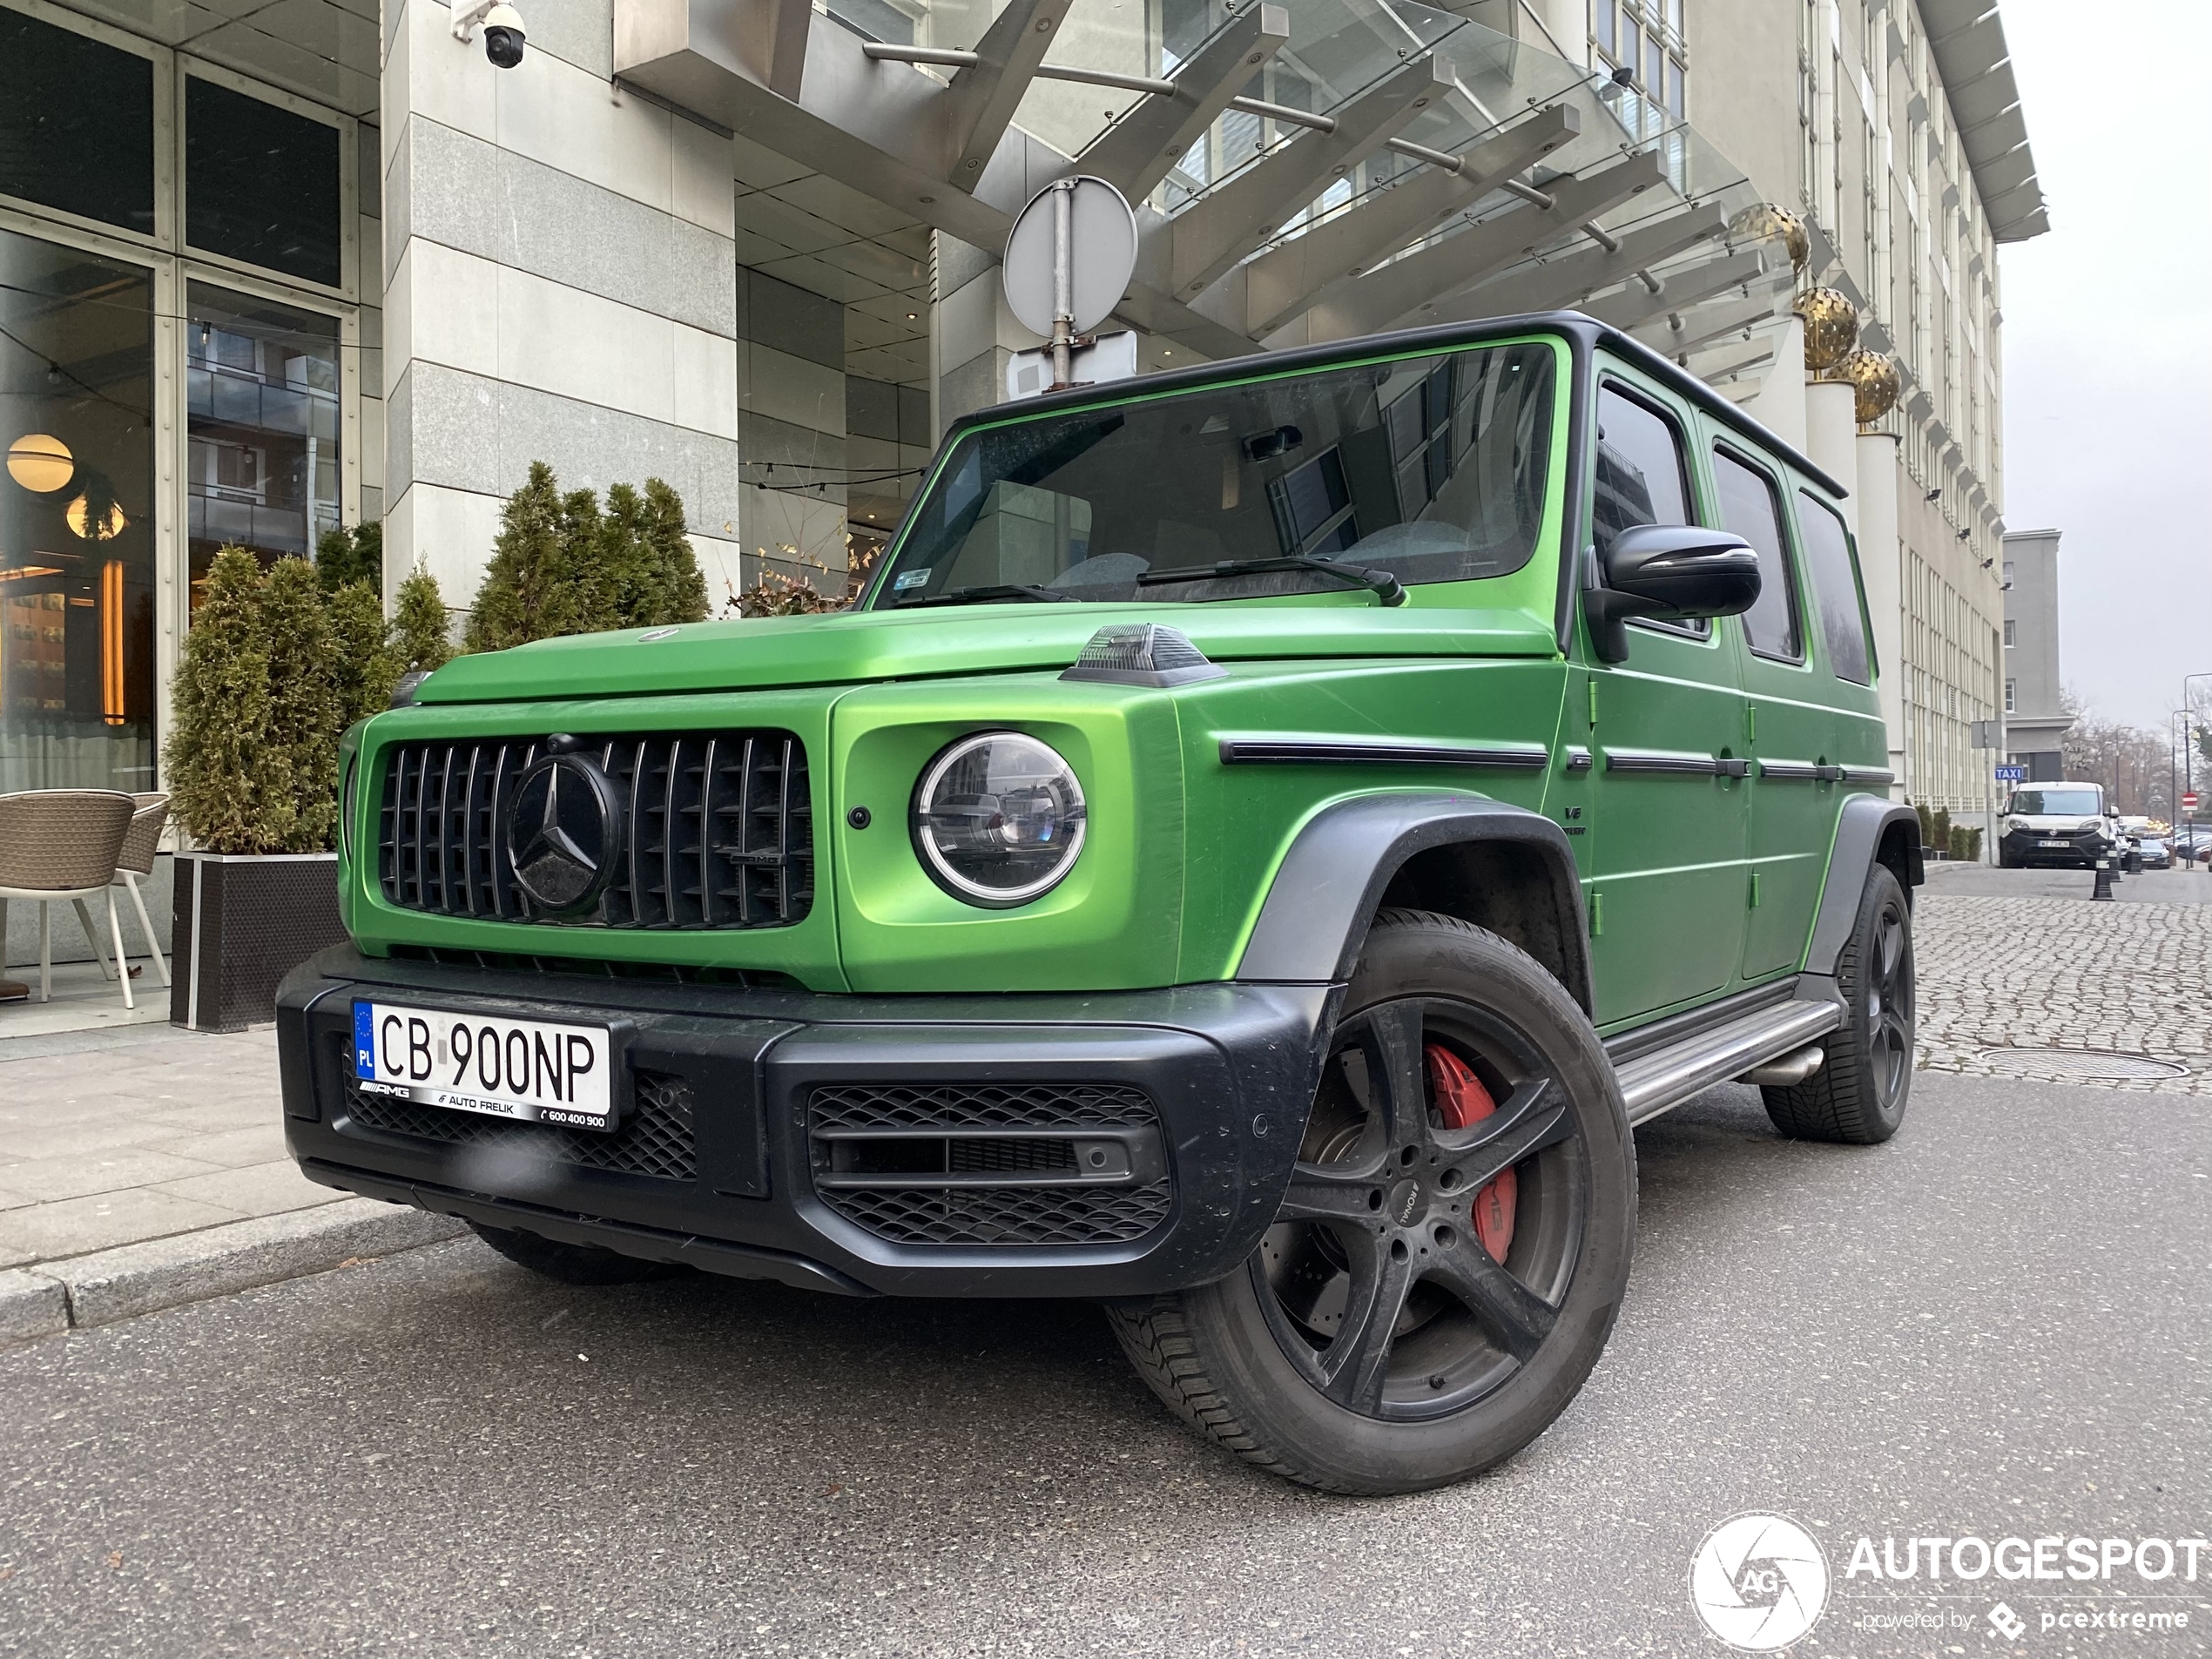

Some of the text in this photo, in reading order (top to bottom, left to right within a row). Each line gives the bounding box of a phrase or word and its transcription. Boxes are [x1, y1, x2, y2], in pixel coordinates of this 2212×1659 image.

[1997, 768, 2021, 779] TAXI
[359, 1049, 373, 1068] PL
[381, 1014, 595, 1103] CB 900NP
[374, 1083, 410, 1098] AMG
[448, 1096, 514, 1115] AUTO FRELIK
[549, 1110, 605, 1128] 600 400 900
[1400, 1190, 1418, 1223] RONAL
[1489, 1179, 1504, 1231] MG
